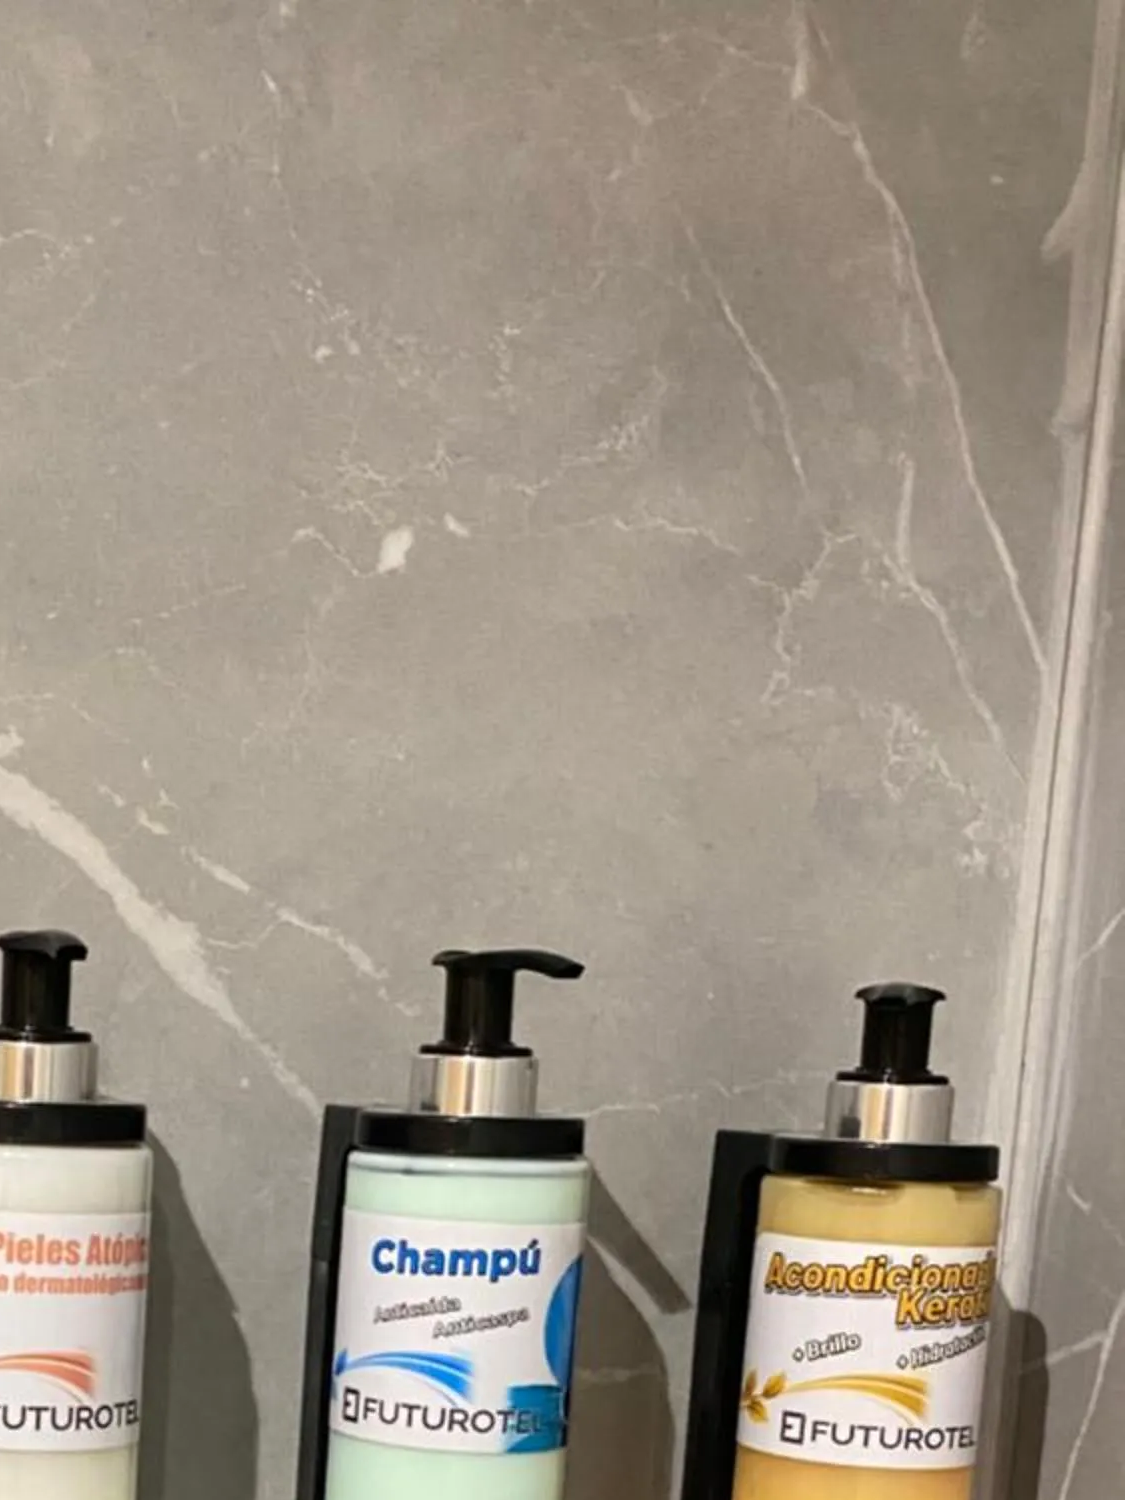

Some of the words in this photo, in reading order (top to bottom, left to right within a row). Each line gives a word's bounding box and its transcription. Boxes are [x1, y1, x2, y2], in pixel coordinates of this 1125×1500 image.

[371, 1237, 542, 1283] Champú
[806, 1331, 862, 1362] Brillo
[362, 1396, 543, 1435] FUTUROTEL
